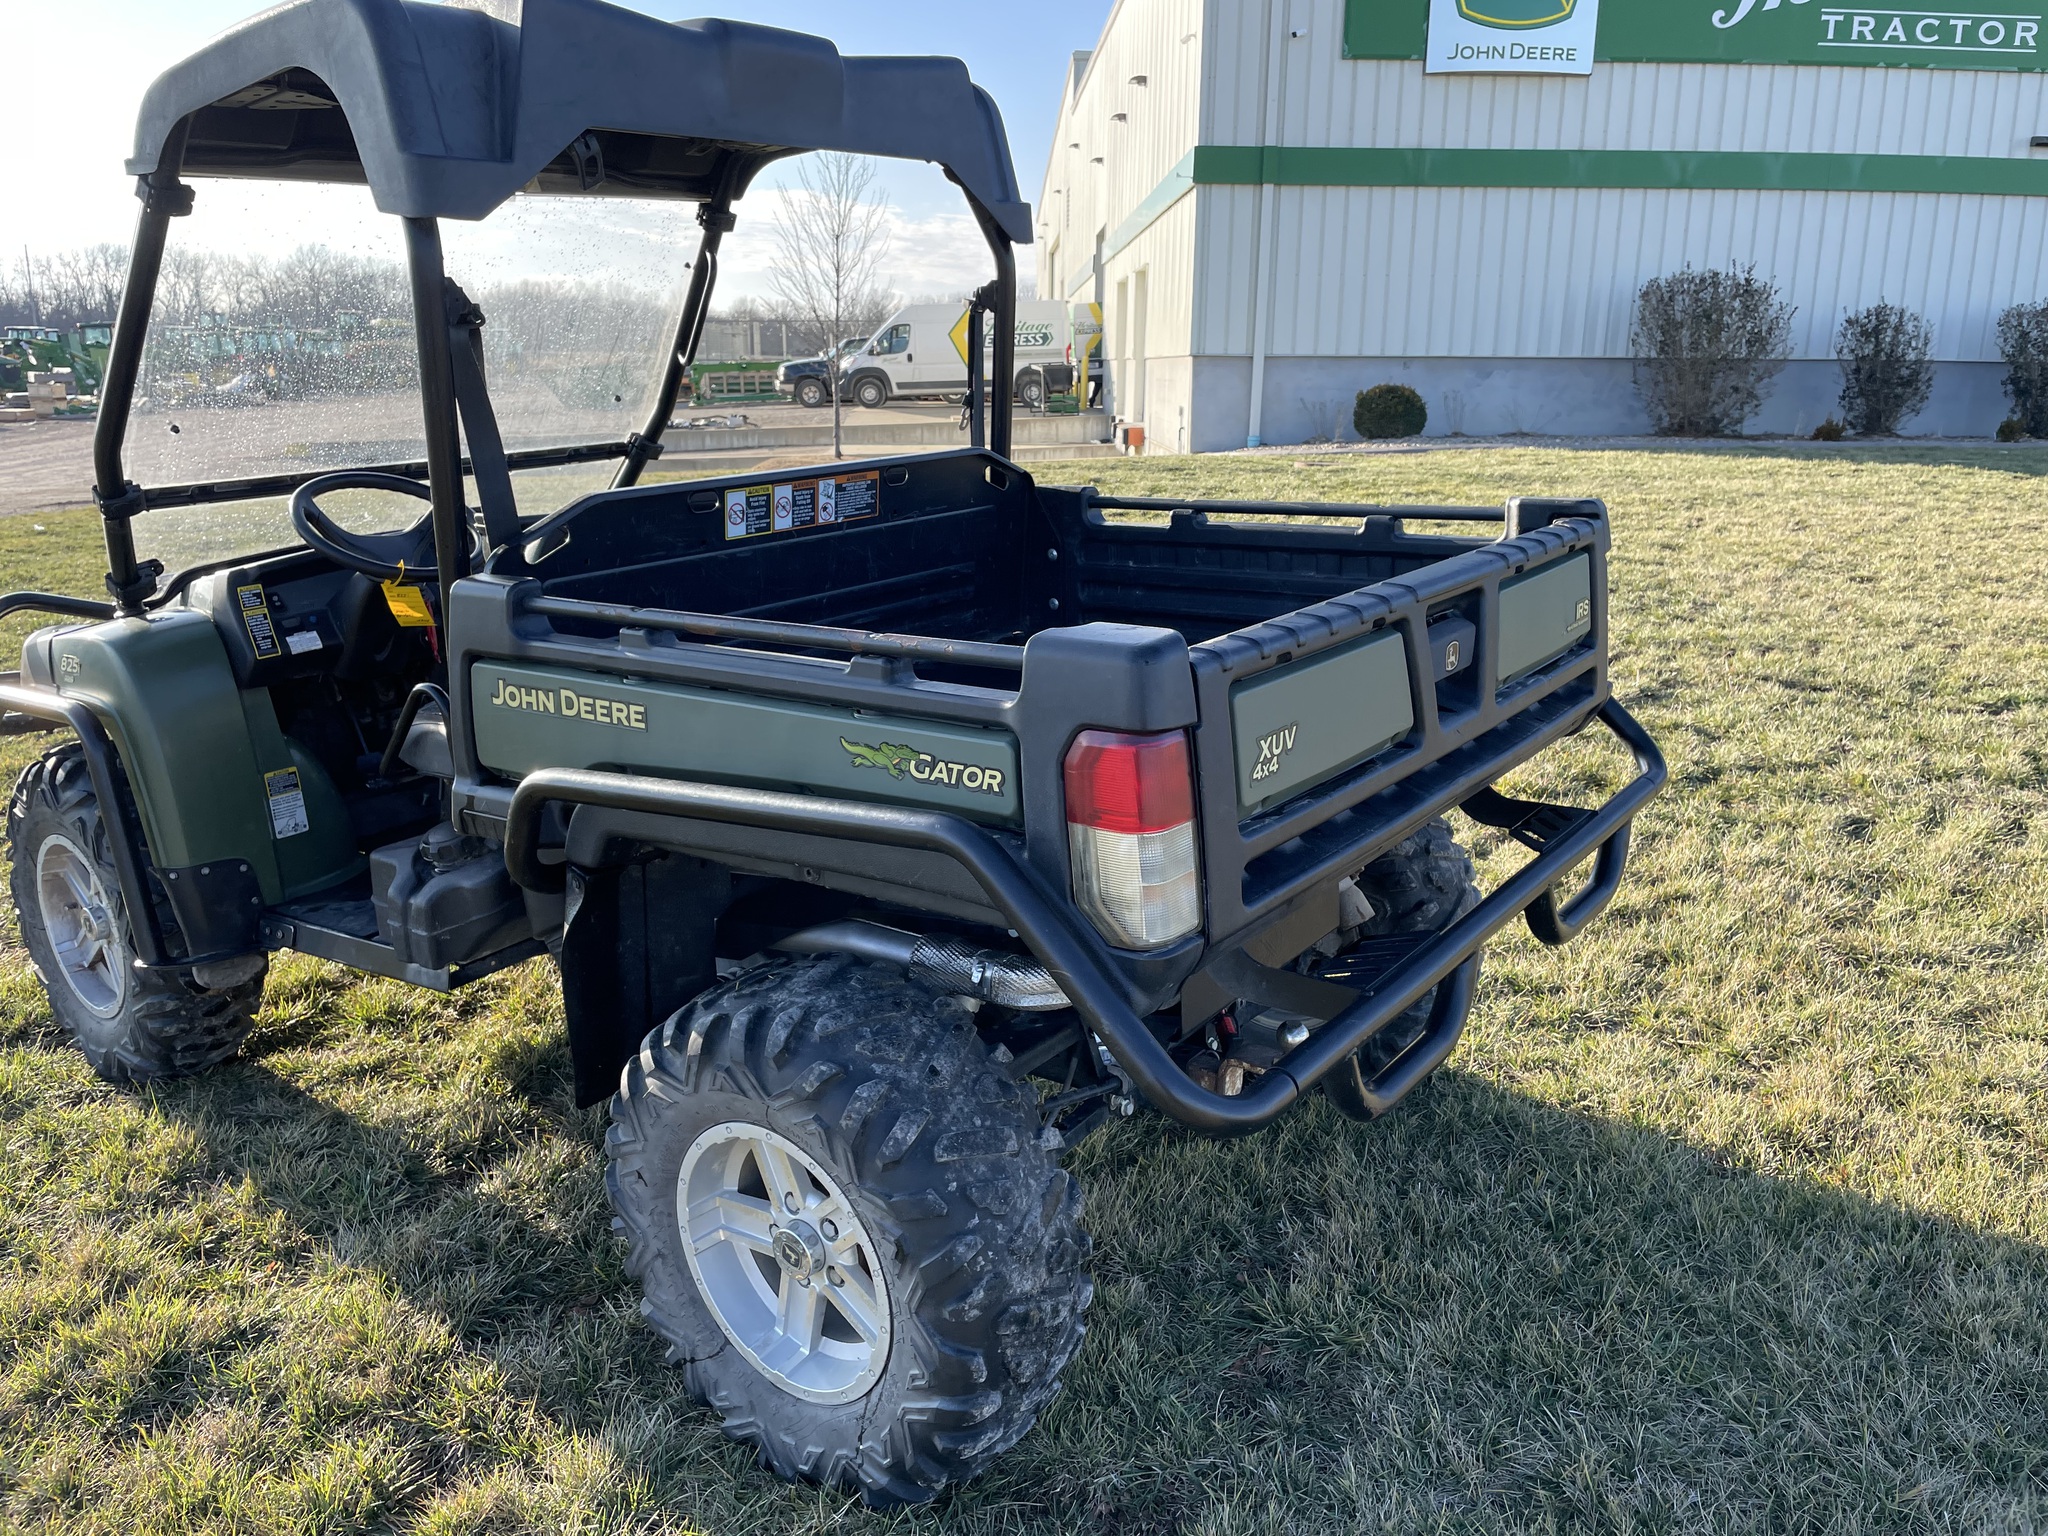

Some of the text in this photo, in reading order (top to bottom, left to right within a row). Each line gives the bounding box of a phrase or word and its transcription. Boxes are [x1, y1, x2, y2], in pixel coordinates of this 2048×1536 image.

[1821, 14, 2039, 46] TRACTOR
[1447, 43, 1577, 62] JOHN DEERE
[984, 333, 1044, 346] ERESS
[1576, 600, 1589, 620] IRS
[492, 680, 646, 729] JOHN DEERE
[1259, 725, 1297, 762] XUV
[909, 753, 1004, 794] GATOR
[1253, 756, 1279, 780] 4x4
